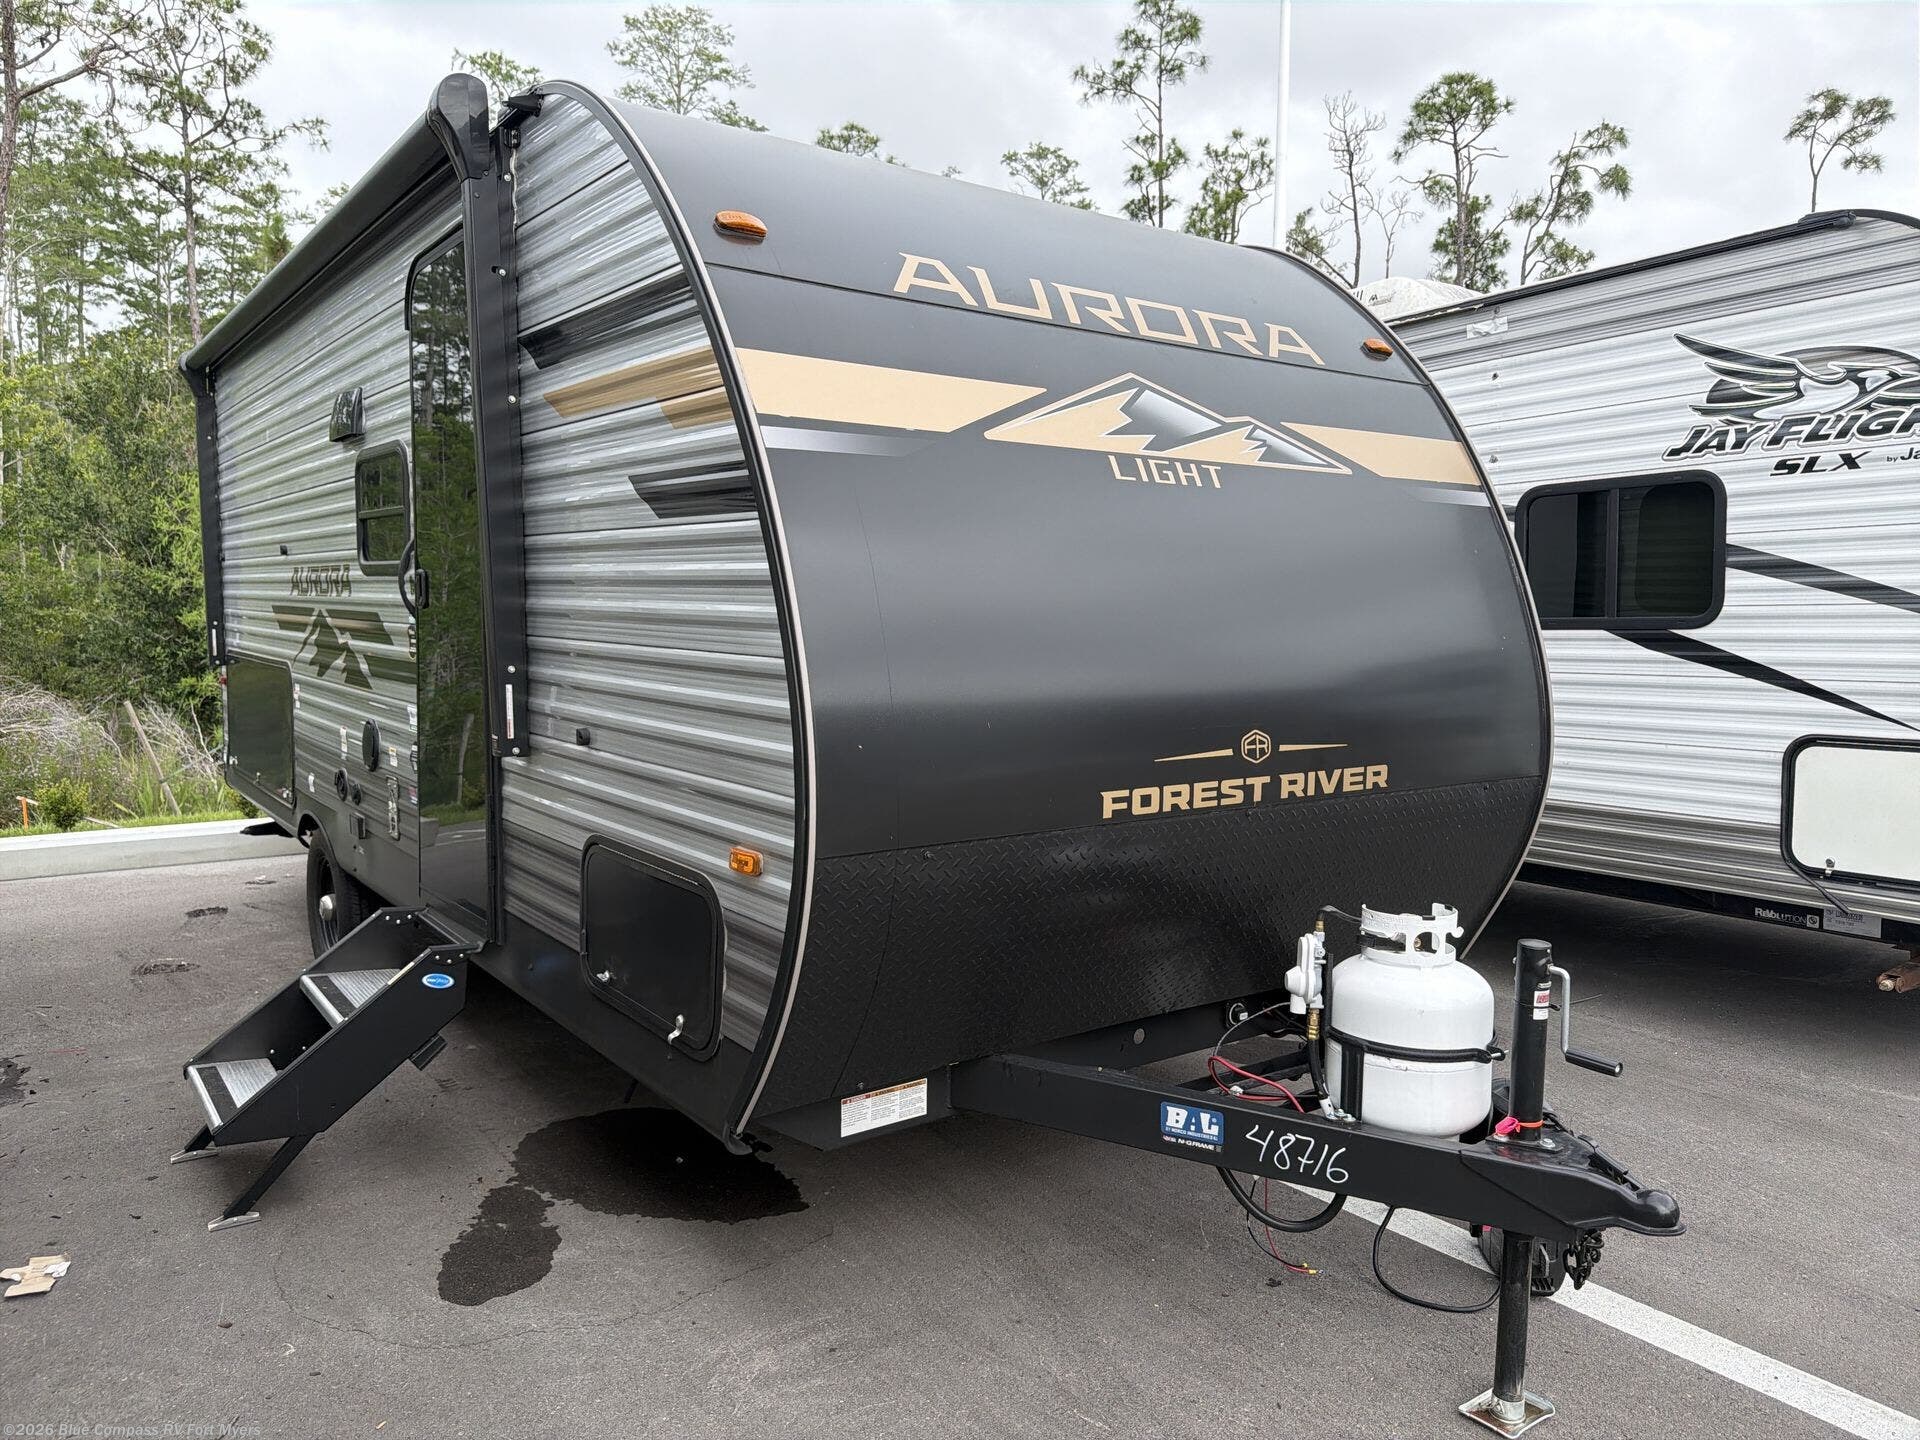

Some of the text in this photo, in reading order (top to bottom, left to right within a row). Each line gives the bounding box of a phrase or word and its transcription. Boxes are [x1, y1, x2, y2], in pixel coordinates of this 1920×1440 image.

[893, 252, 1326, 366] AURORA
[1664, 423, 1773, 457] JAY
[1107, 455, 1222, 489] LIGHT
[1770, 450, 1872, 477] SLX
[289, 563, 352, 597] AURORA
[1100, 764, 1389, 819] FOREST RIVER
[1165, 1105, 1220, 1136] BAL
[1245, 1124, 1349, 1184] 48716
